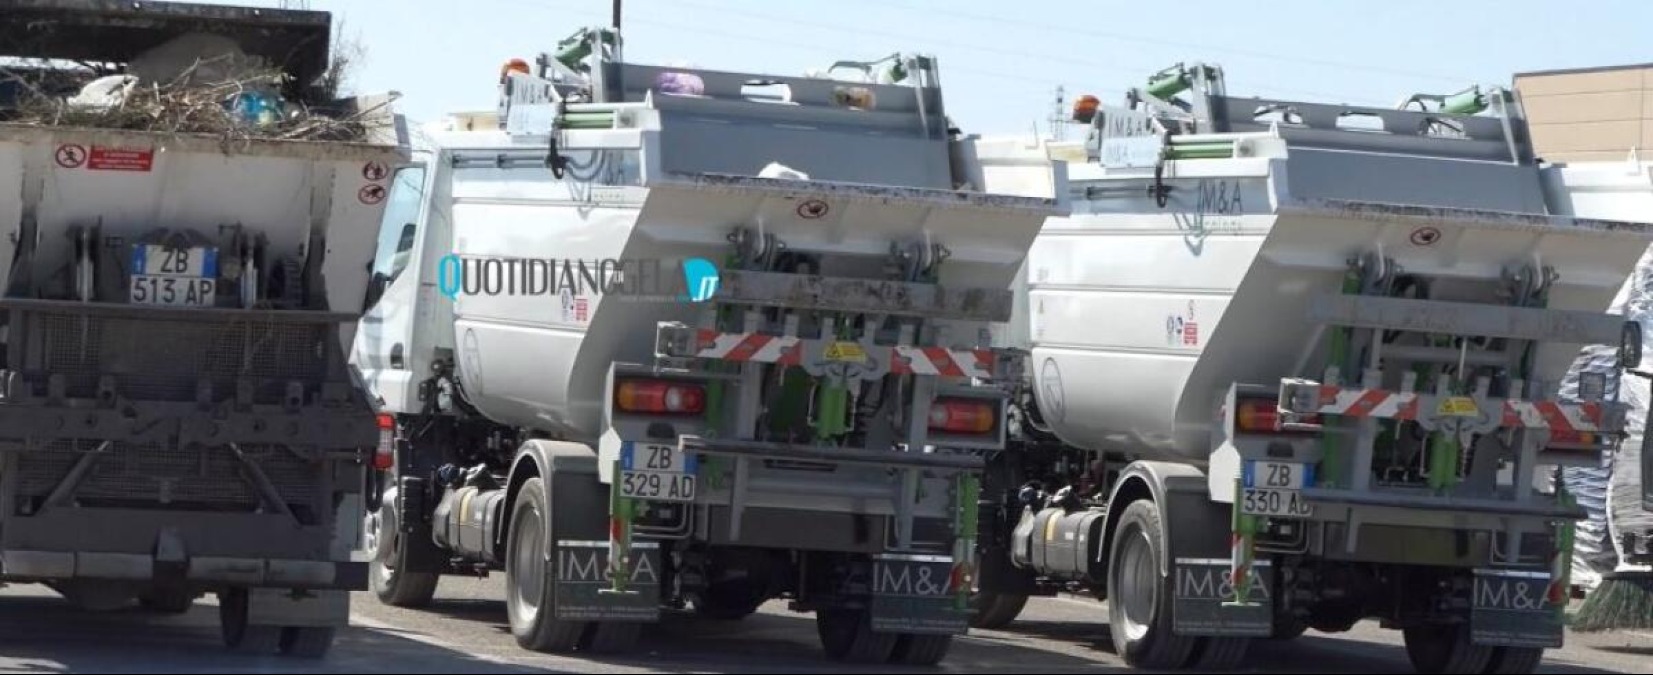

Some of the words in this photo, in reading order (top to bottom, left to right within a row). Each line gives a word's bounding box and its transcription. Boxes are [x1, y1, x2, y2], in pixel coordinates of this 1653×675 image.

[1199, 178, 1242, 214] IM&A
[160, 250, 188, 273] ZB
[133, 278, 176, 303] 513
[186, 280, 212, 303] AP
[646, 446, 673, 470] ZB
[623, 473, 661, 497] 329
[668, 476, 694, 498] AD
[1266, 463, 1291, 487] ZB
[1244, 489, 1279, 512] 330
[557, 550, 658, 582] IMA
